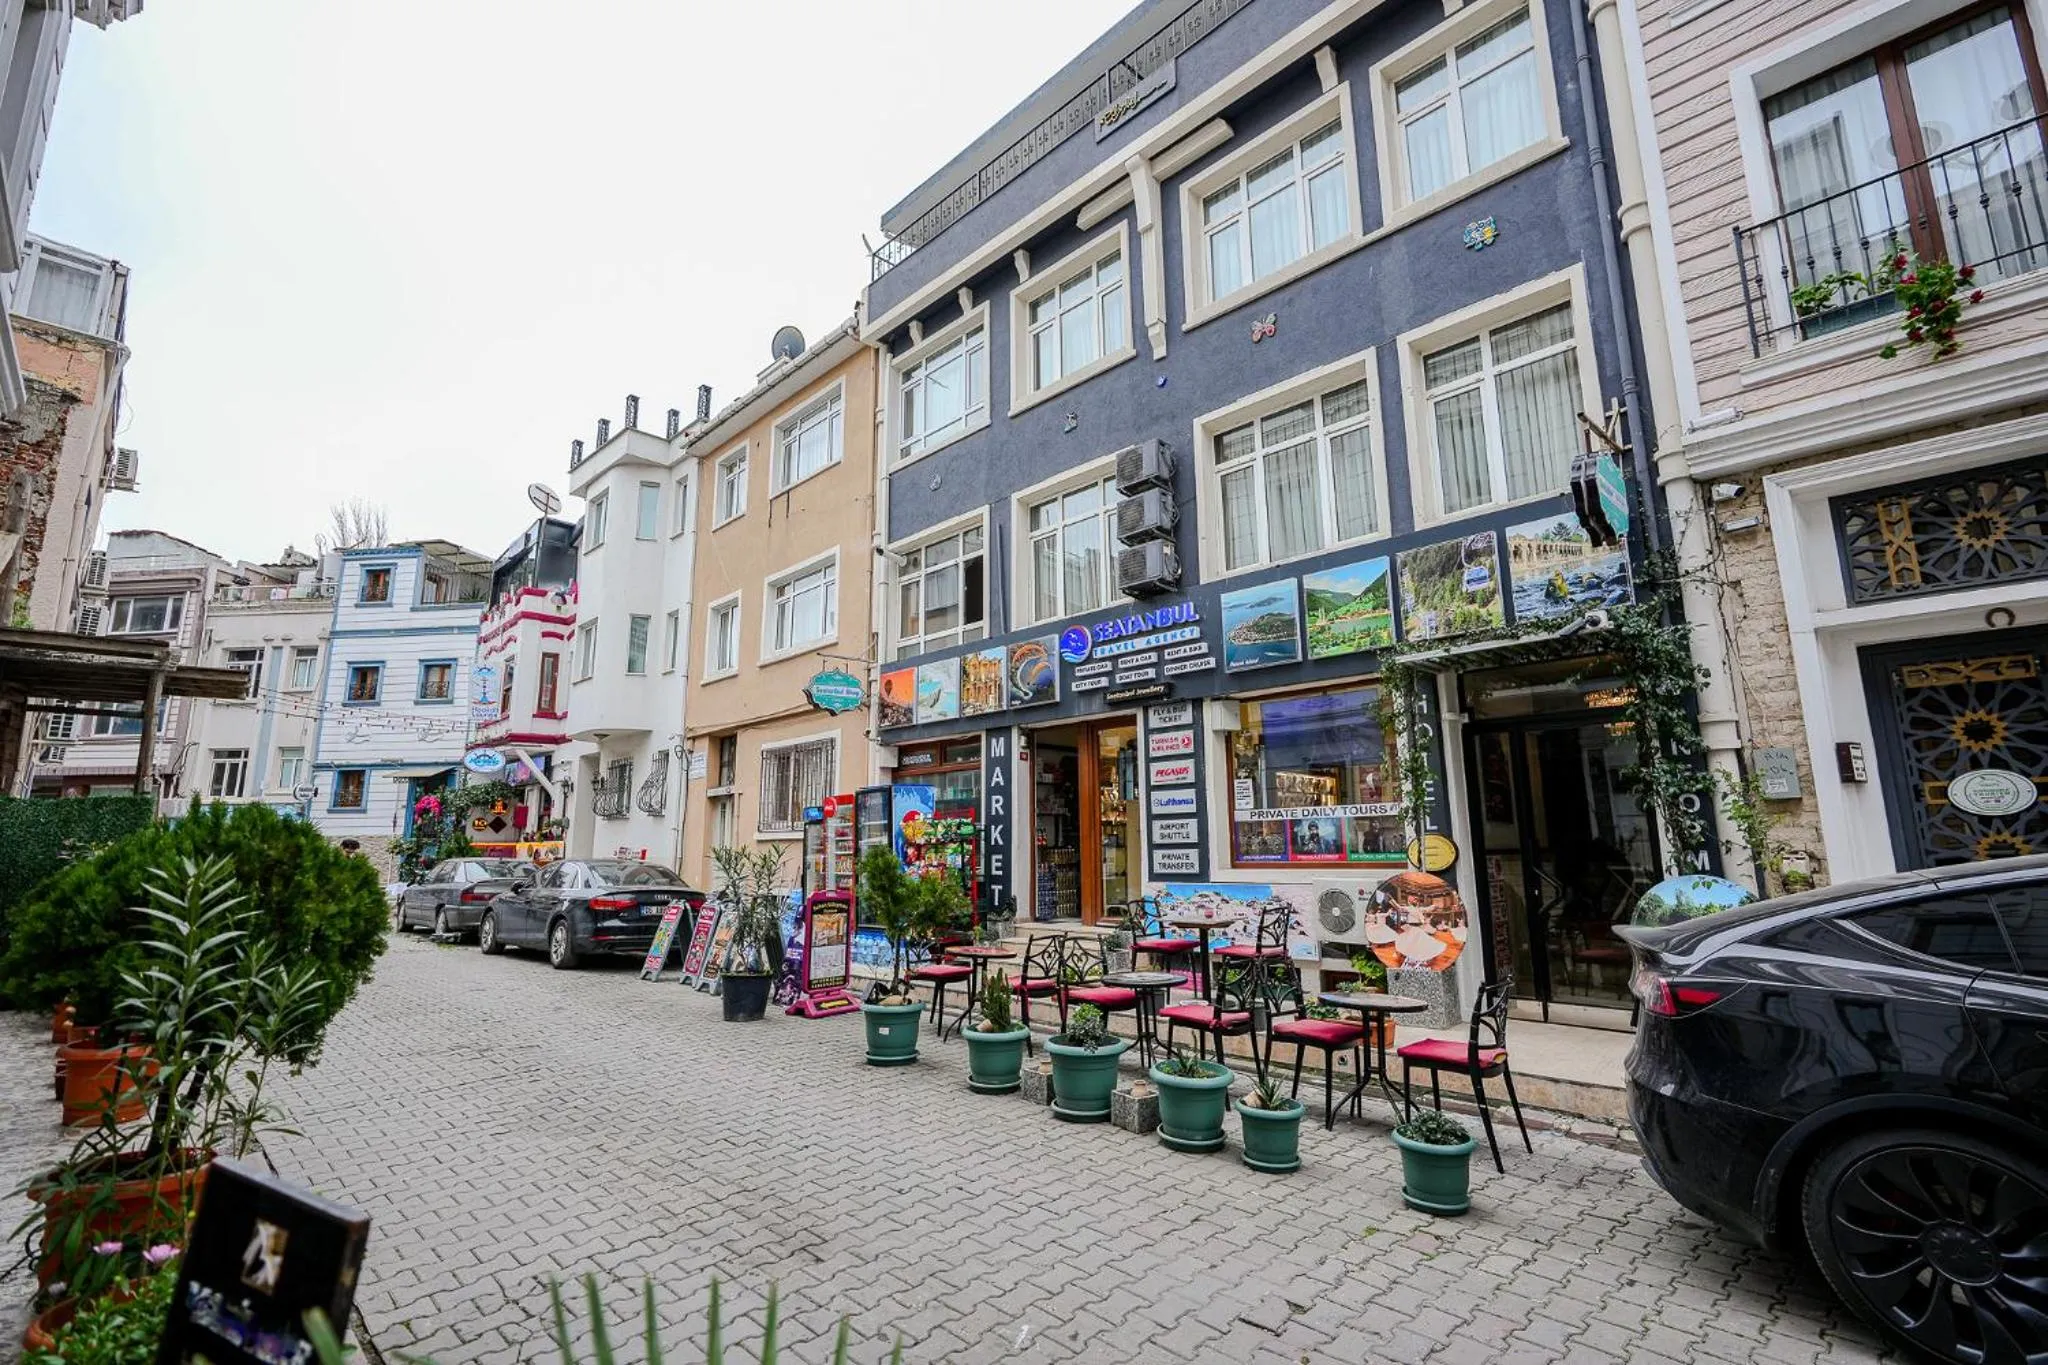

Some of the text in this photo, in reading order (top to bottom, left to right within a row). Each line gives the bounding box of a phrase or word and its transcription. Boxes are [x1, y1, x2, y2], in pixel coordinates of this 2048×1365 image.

[1093, 602, 1199, 642] SEATANBUL
[1094, 627, 1196, 657] TRAVEL AGENCY
[1167, 648, 1181, 656] RENT
[1119, 657, 1134, 666] RENT
[1165, 659, 1211, 673] DINNER CRUISE
[1118, 670, 1149, 681] BOAT TOUR
[1153, 706, 1165, 716] FLY
[1159, 714, 1182, 723] TICKET
[1151, 736, 1179, 745] TURKISH
[1151, 744, 1180, 752] AIRLINES
[1155, 766, 1190, 777] PEGASUS
[1160, 797, 1194, 807] Lufthansa
[1250, 804, 1388, 820] PRIVATE DAILY TOURS
[990, 736, 1005, 906] MARKET
[1160, 822, 1190, 831] AIRPORT
[1160, 832, 1190, 840] SHUTTLE
[1161, 852, 1190, 861] PRIVATE
[1157, 862, 1196, 871] TRANSFER
